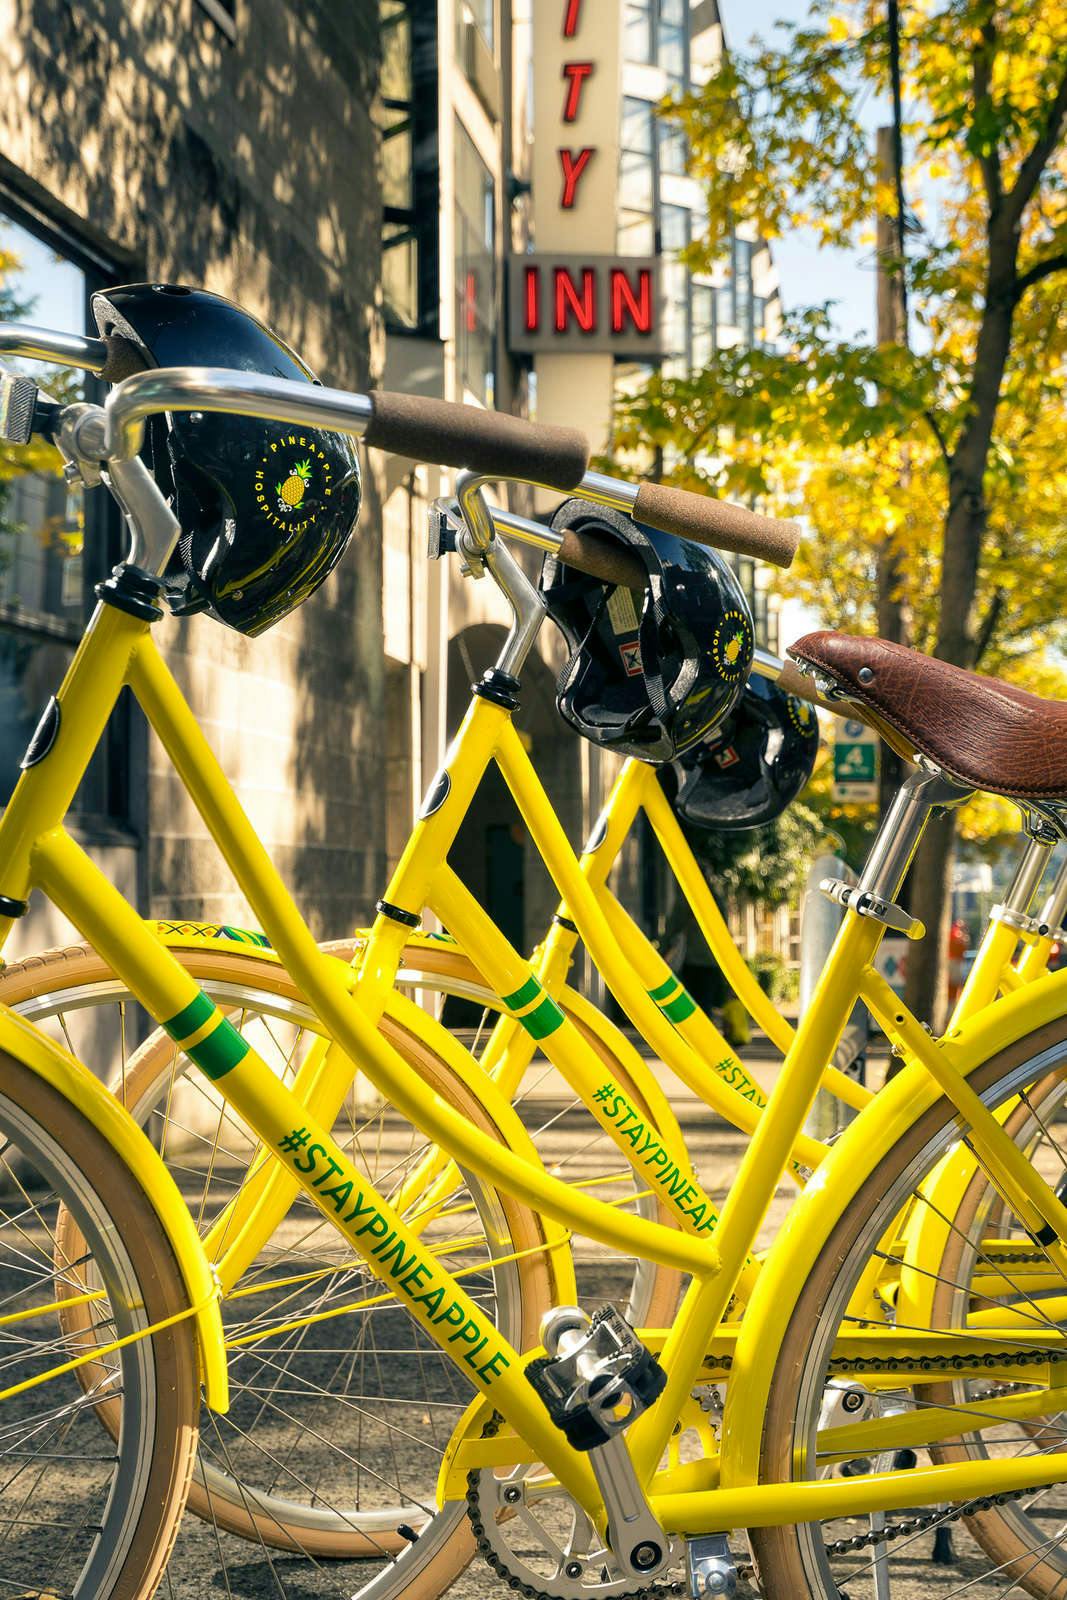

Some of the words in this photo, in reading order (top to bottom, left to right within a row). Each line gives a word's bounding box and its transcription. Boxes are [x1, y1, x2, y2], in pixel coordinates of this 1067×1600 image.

[525, 265, 653, 333] INN
[270, 435, 332, 496] PINEAPPLE
[255, 470, 316, 532] HOSPITALITY
[277, 1127, 511, 1386] #STAYPINEAPPLE
